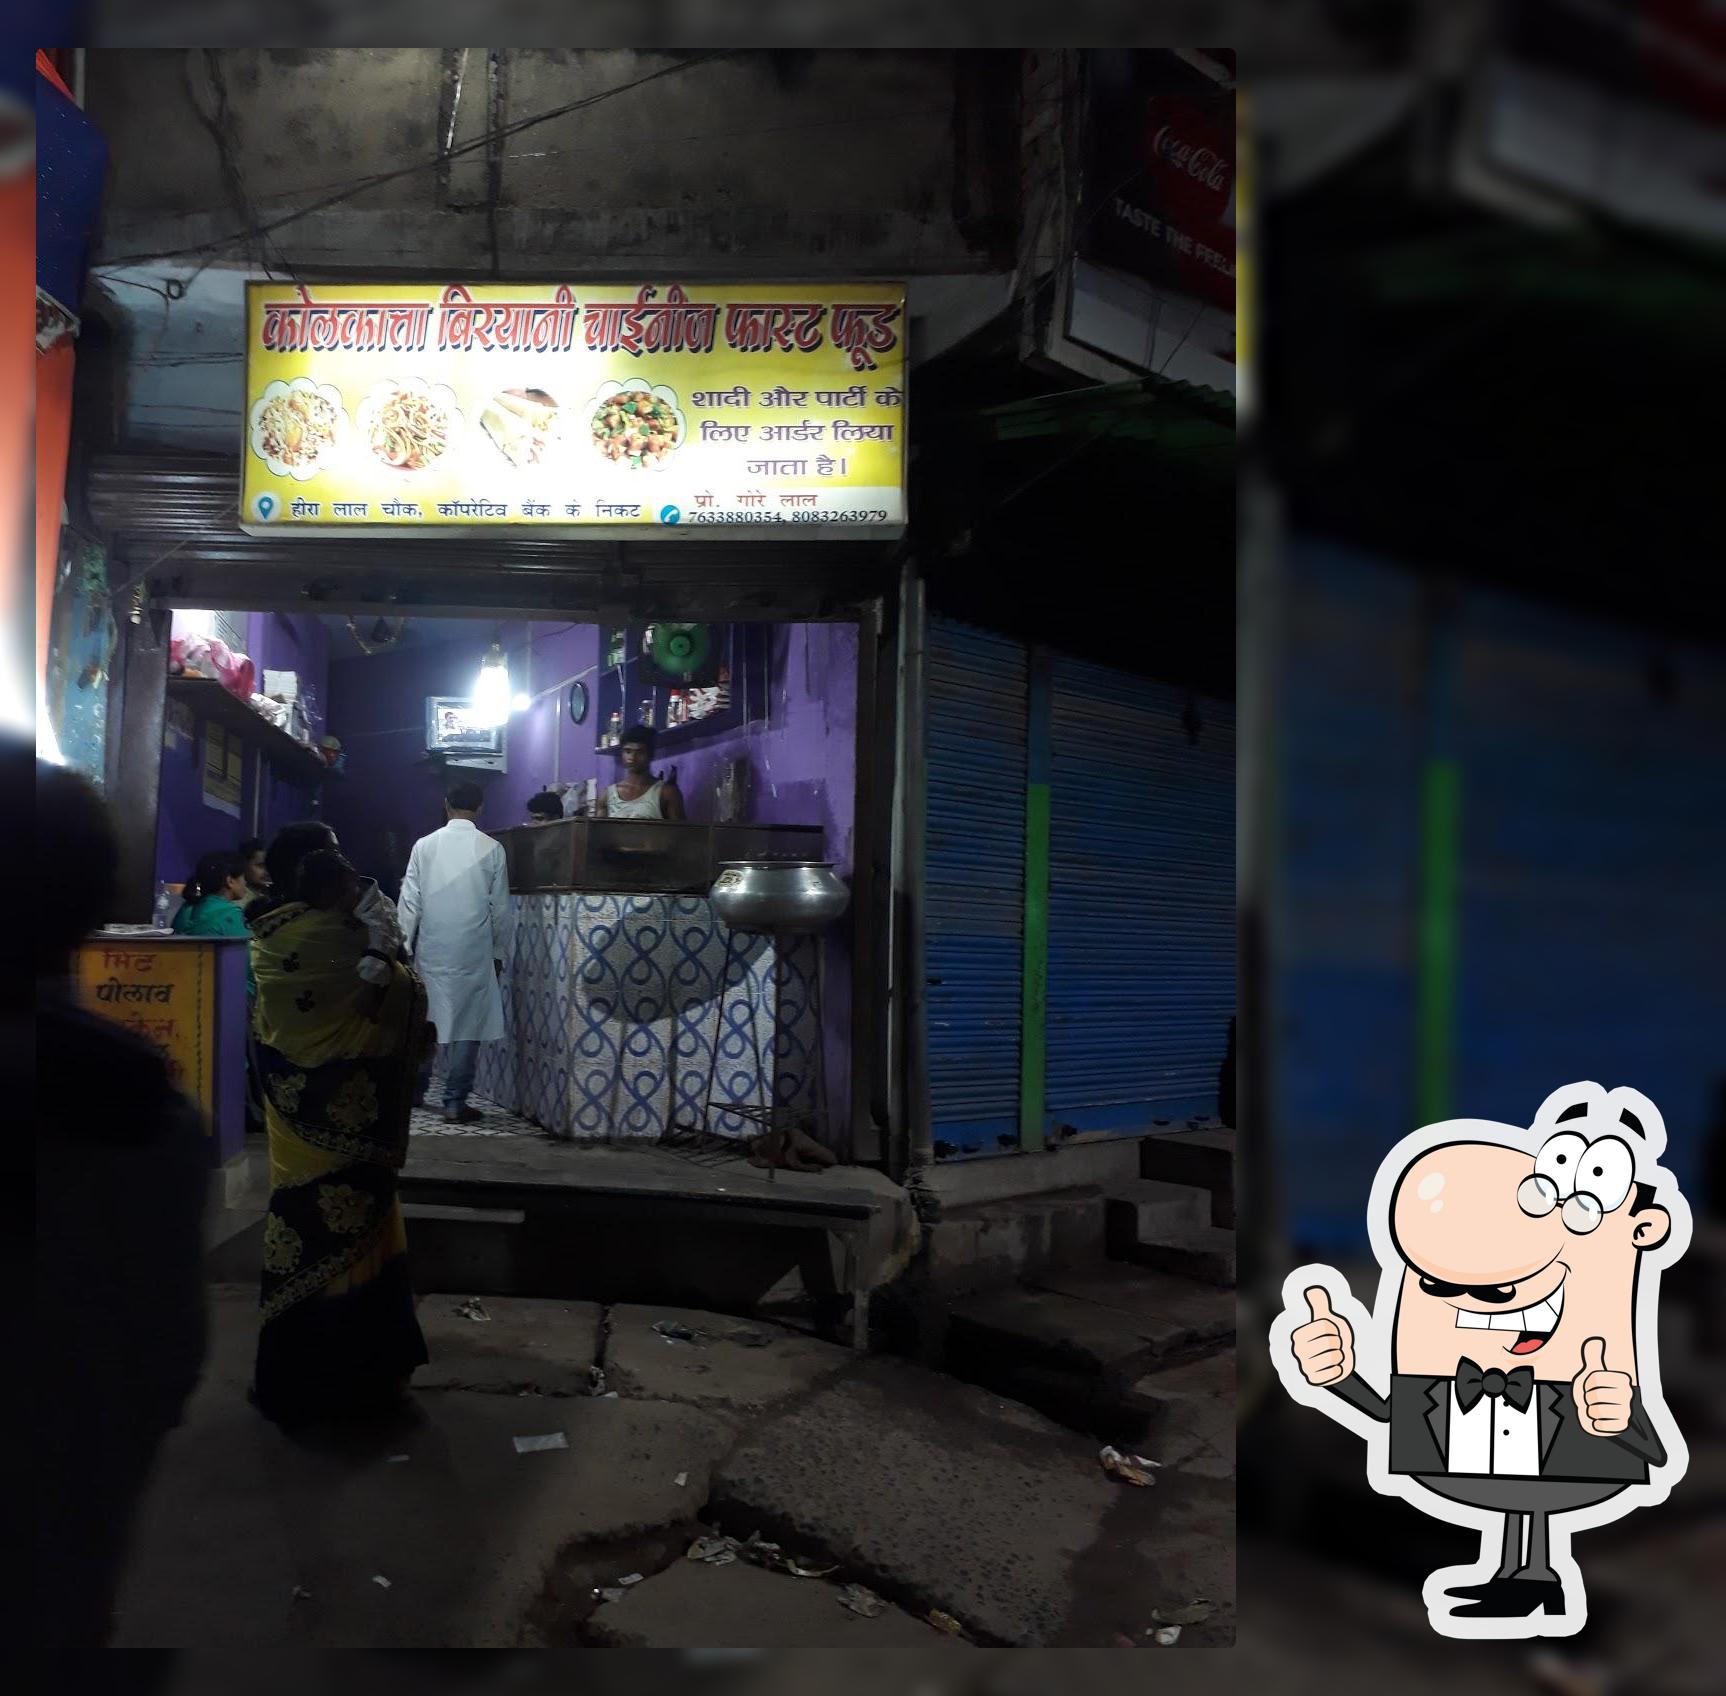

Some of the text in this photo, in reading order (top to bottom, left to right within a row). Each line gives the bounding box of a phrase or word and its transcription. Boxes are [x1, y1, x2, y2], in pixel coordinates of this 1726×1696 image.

[1115, 197, 1163, 238] TASTE
[1165, 225, 1194, 256] THE
[438, 283, 578, 352] बिरयानी
[724, 302, 827, 353] फास्ट
[830, 302, 901, 371] फूड
[692, 386, 904, 407] शादी और पार्टी के
[700, 420, 895, 441] लिए आर्डर लिया
[747, 459, 808, 475] जाता
[291, 497, 320, 518] हीरा
[333, 503, 368, 517] लाल
[437, 498, 508, 517] कॉपरेटिव
[521, 499, 551, 517] बैंक
[595, 499, 641, 517] निकट
[736, 489, 767, 508] गोरे
[779, 494, 818, 507] लाल
[792, 510, 887, 523] 8083263979
